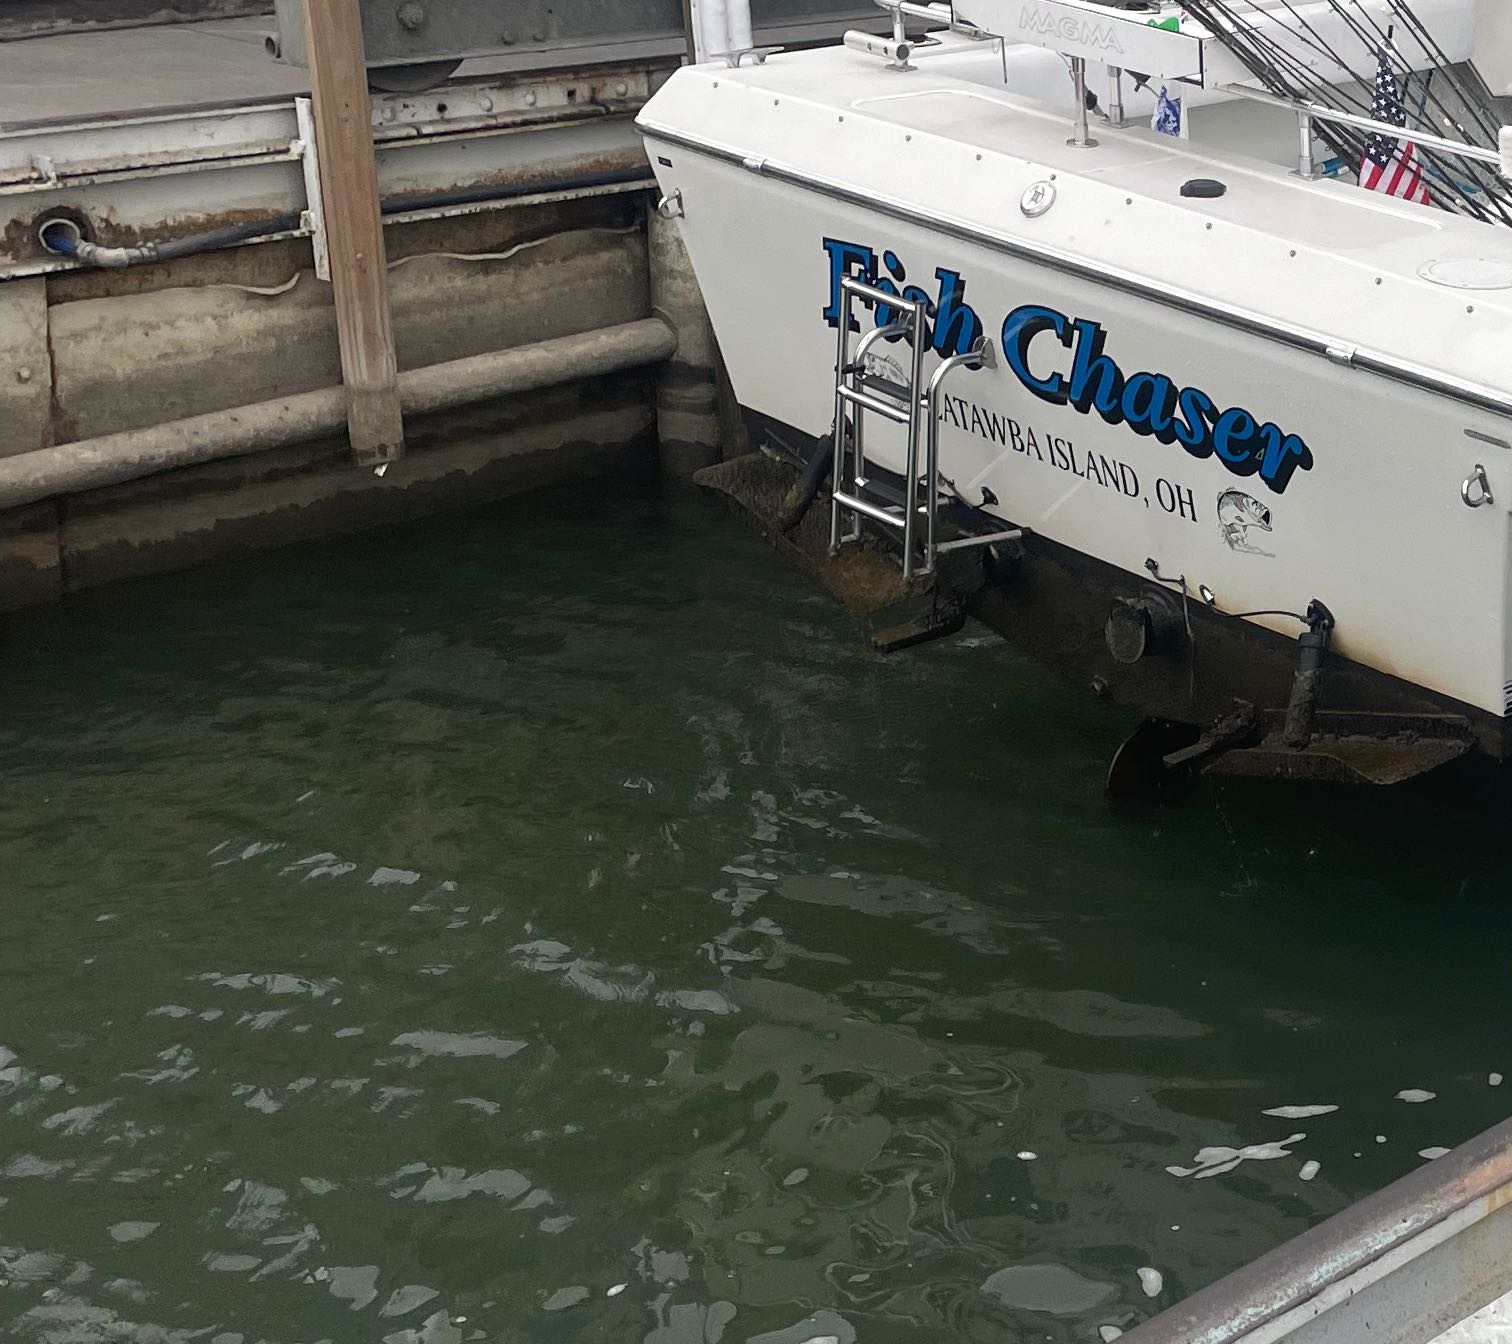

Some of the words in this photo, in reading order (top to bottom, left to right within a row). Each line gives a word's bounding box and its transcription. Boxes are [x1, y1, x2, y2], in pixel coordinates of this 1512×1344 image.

[1018, 6, 1125, 54] MAGMA
[938, 393, 1044, 461] ATAWBA
[1046, 434, 1150, 508] ISLAND,
[1155, 478, 1198, 523] OH
[1001, 304, 1314, 494] Chaser
